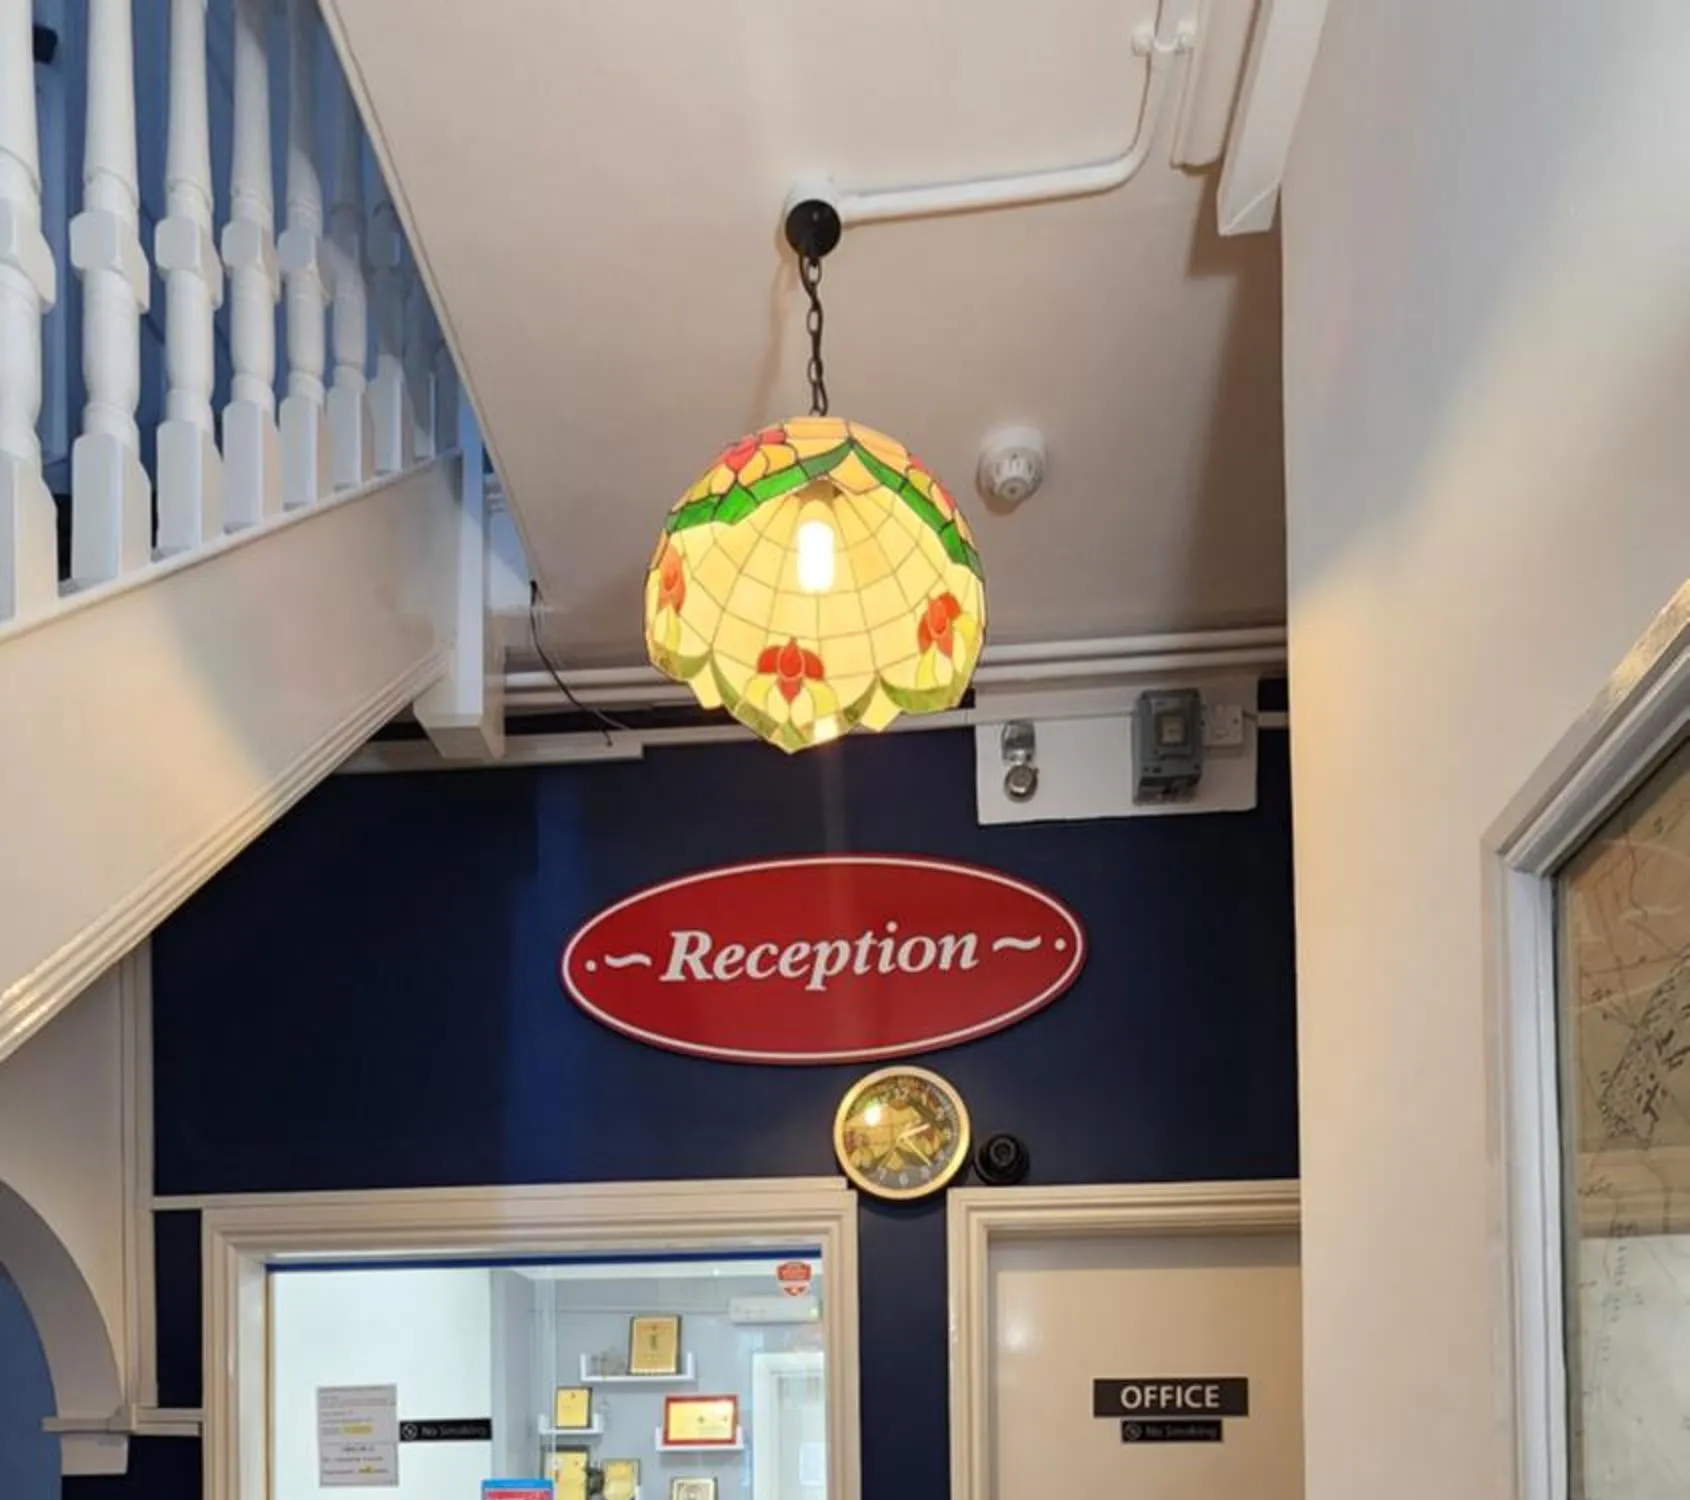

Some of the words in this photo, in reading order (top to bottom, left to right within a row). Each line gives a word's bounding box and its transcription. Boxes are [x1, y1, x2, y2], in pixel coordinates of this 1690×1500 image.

[660, 921, 978, 992] Reception
[1120, 1384, 1220, 1409] OFFICE
[421, 1425, 438, 1438] No
[1145, 1424, 1163, 1437] No
